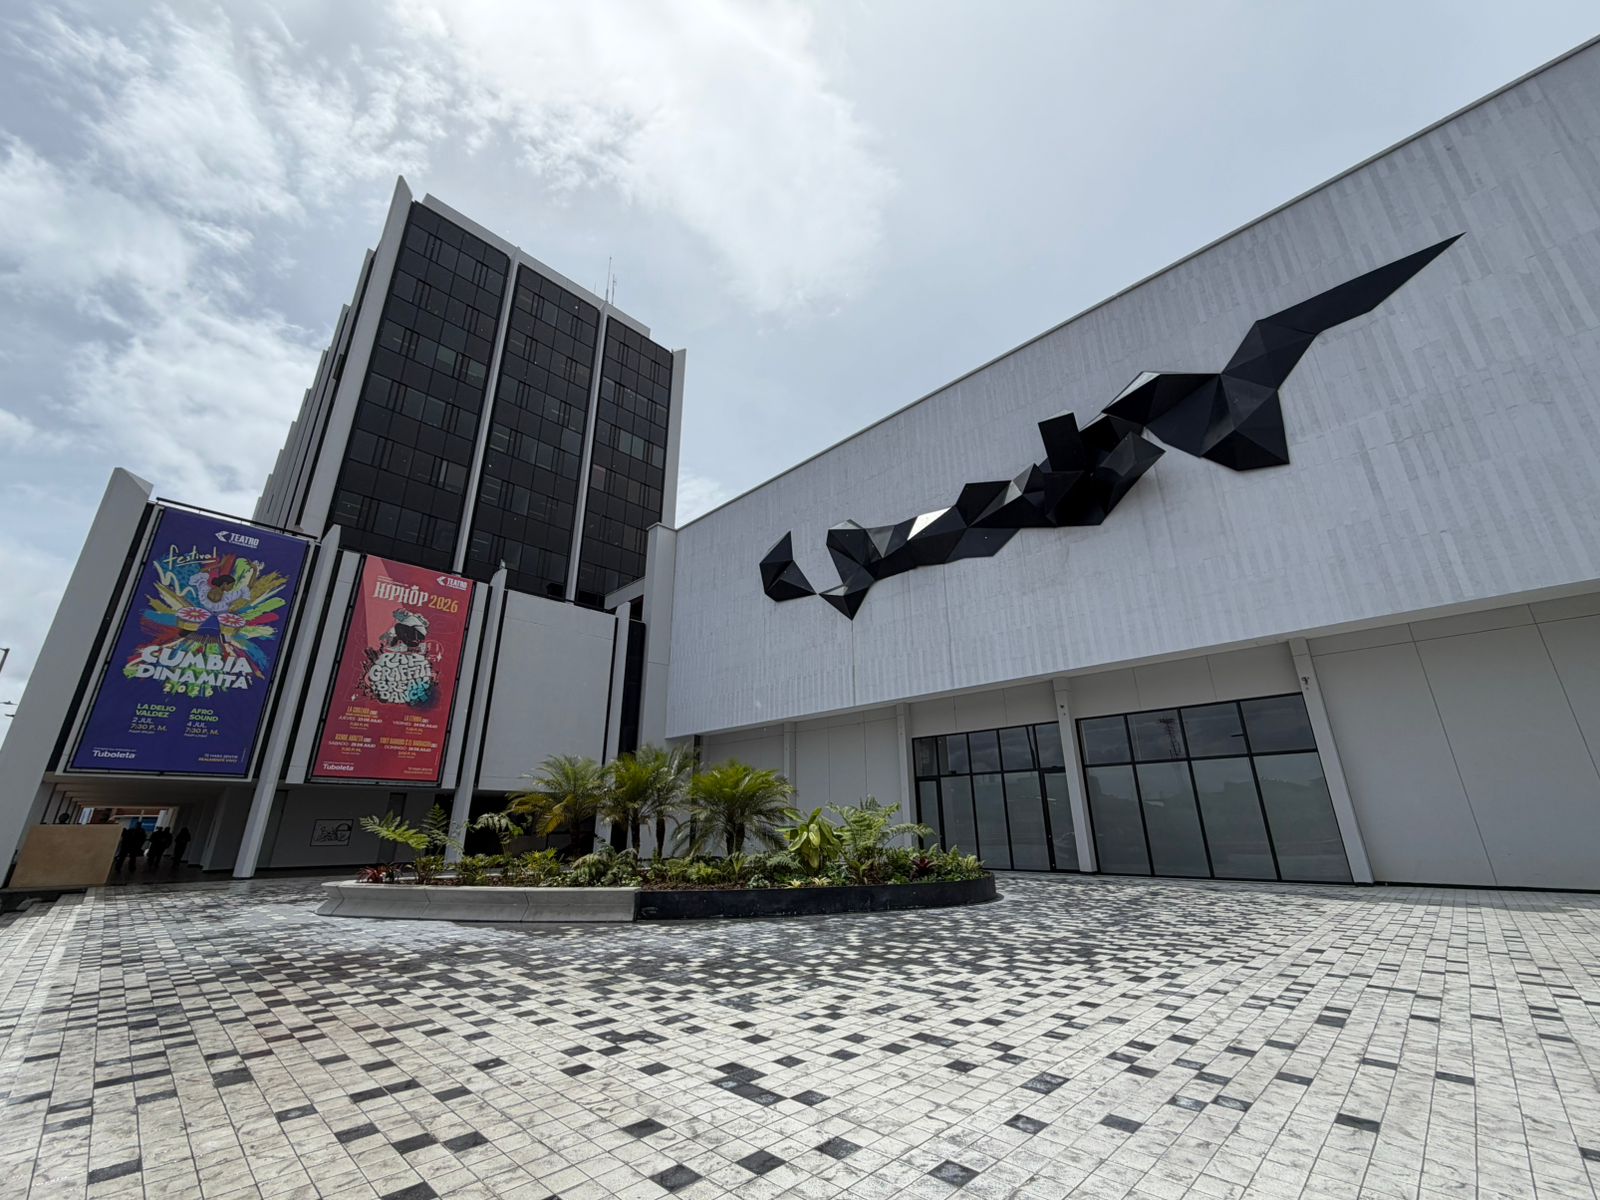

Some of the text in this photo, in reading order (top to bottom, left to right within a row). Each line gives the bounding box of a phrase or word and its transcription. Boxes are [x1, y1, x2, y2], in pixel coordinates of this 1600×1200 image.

[231, 532, 260, 546] TEATRO
[163, 544, 217, 570] festival
[428, 594, 459, 613] 2026
[140, 645, 253, 674] CUMBIA
[375, 653, 425, 668] RAP
[134, 664, 249, 690] DINAMITA
[163, 683, 214, 698] 2026
[374, 677, 430, 693] BREAK
[135, 709, 170, 718] VALDEZ
[150, 703, 176, 712] DELIO
[189, 714, 219, 722] SOUND
[92, 750, 136, 759] Tuboleta
[323, 763, 354, 771] Tuboleta
